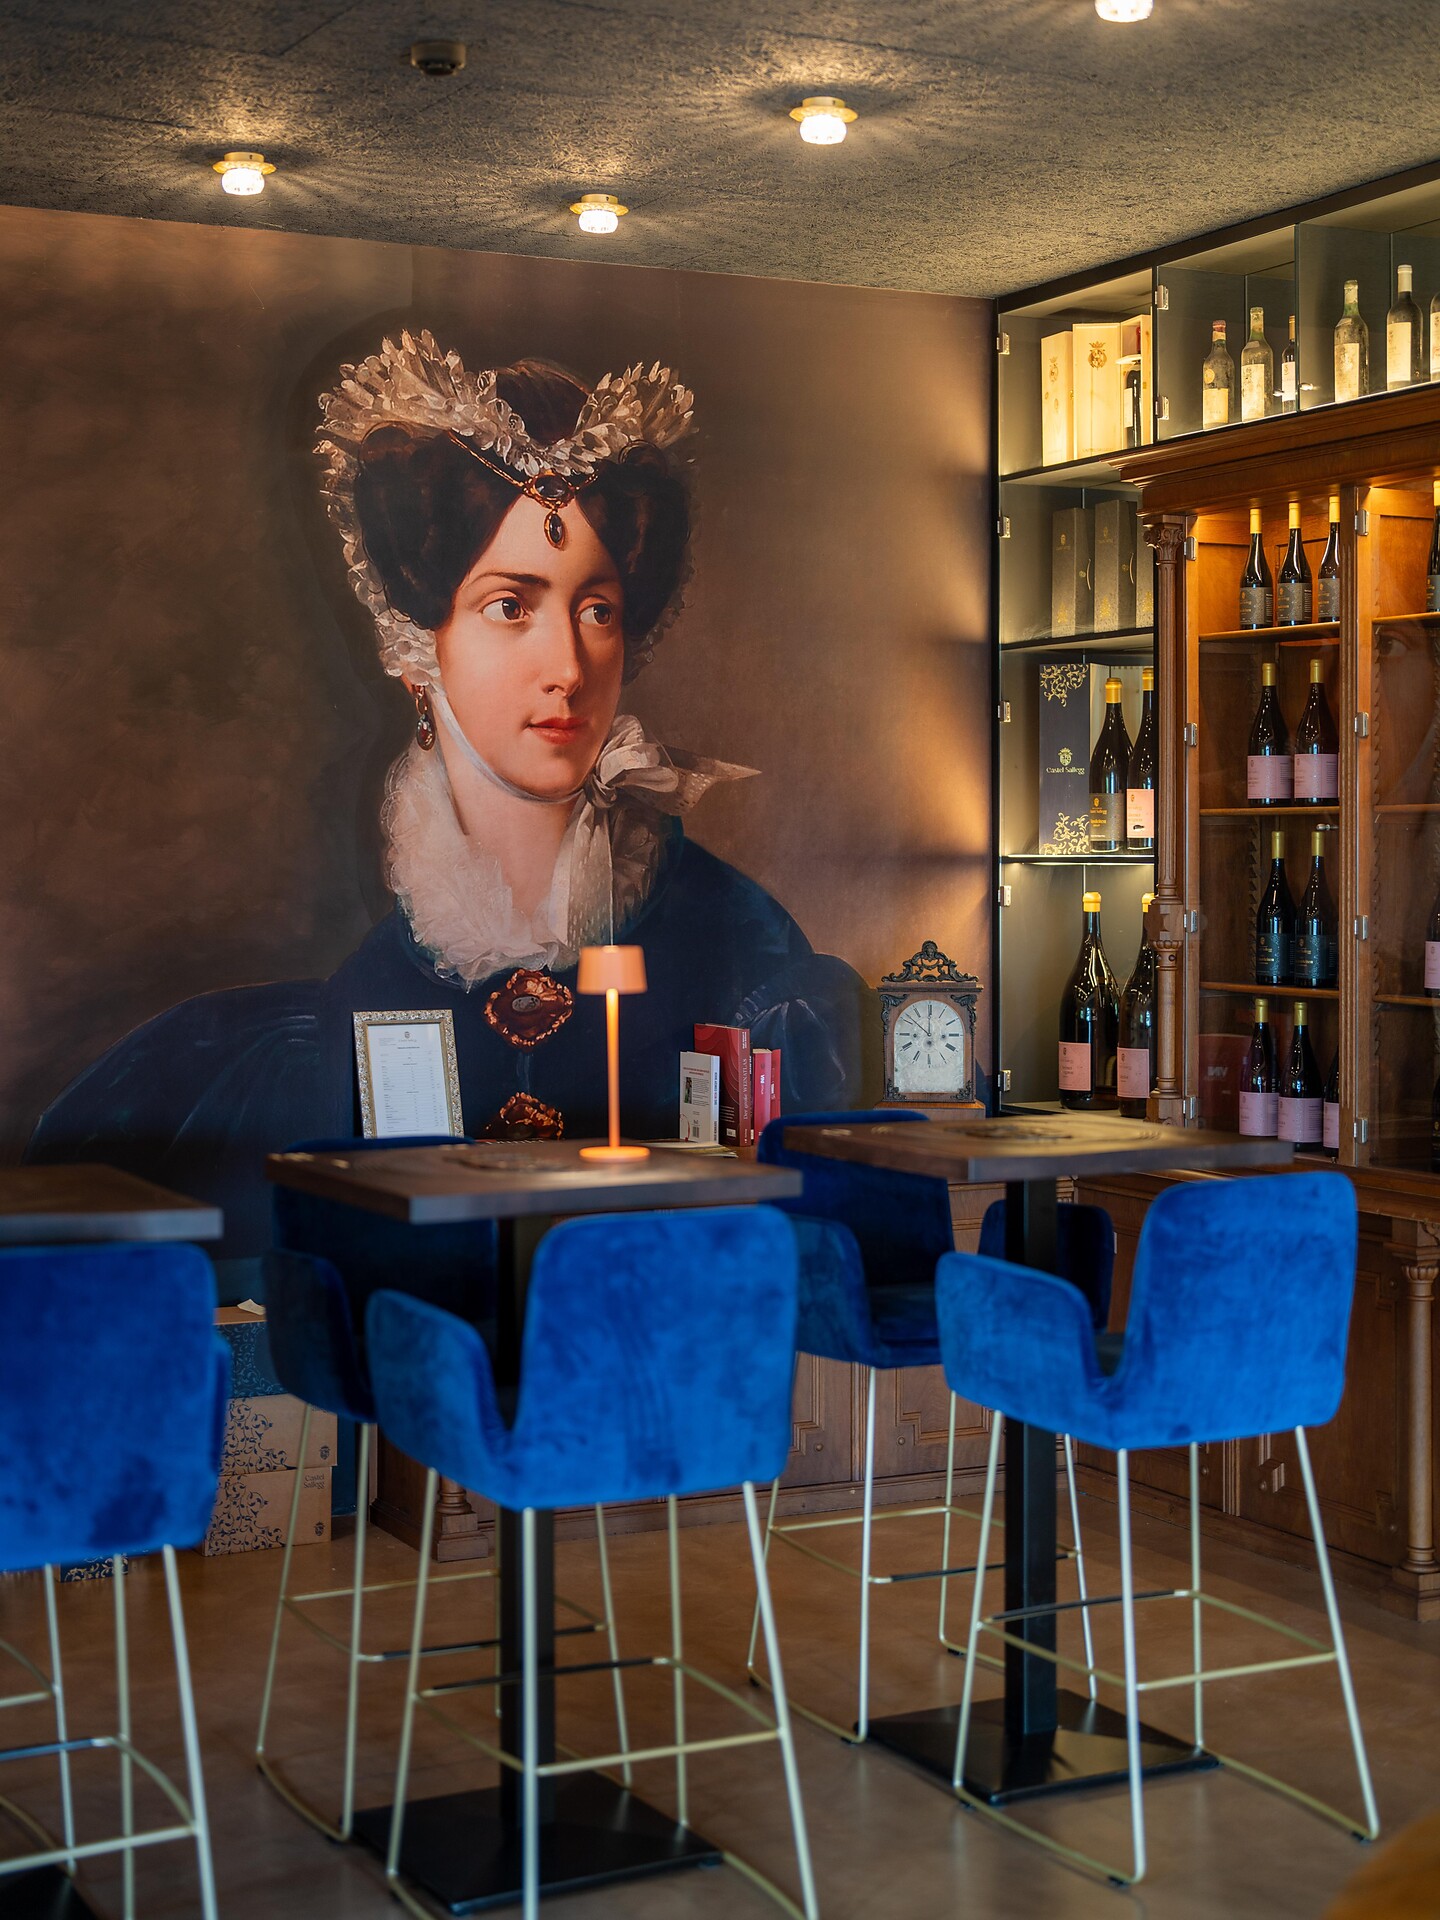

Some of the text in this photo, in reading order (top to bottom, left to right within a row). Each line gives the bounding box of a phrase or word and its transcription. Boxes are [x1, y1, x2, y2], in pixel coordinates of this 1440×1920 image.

[1065, 767, 1085, 775] Sallegg
[304, 1474, 324, 1482] Castel
[303, 1481, 324, 1489] Sallegg
